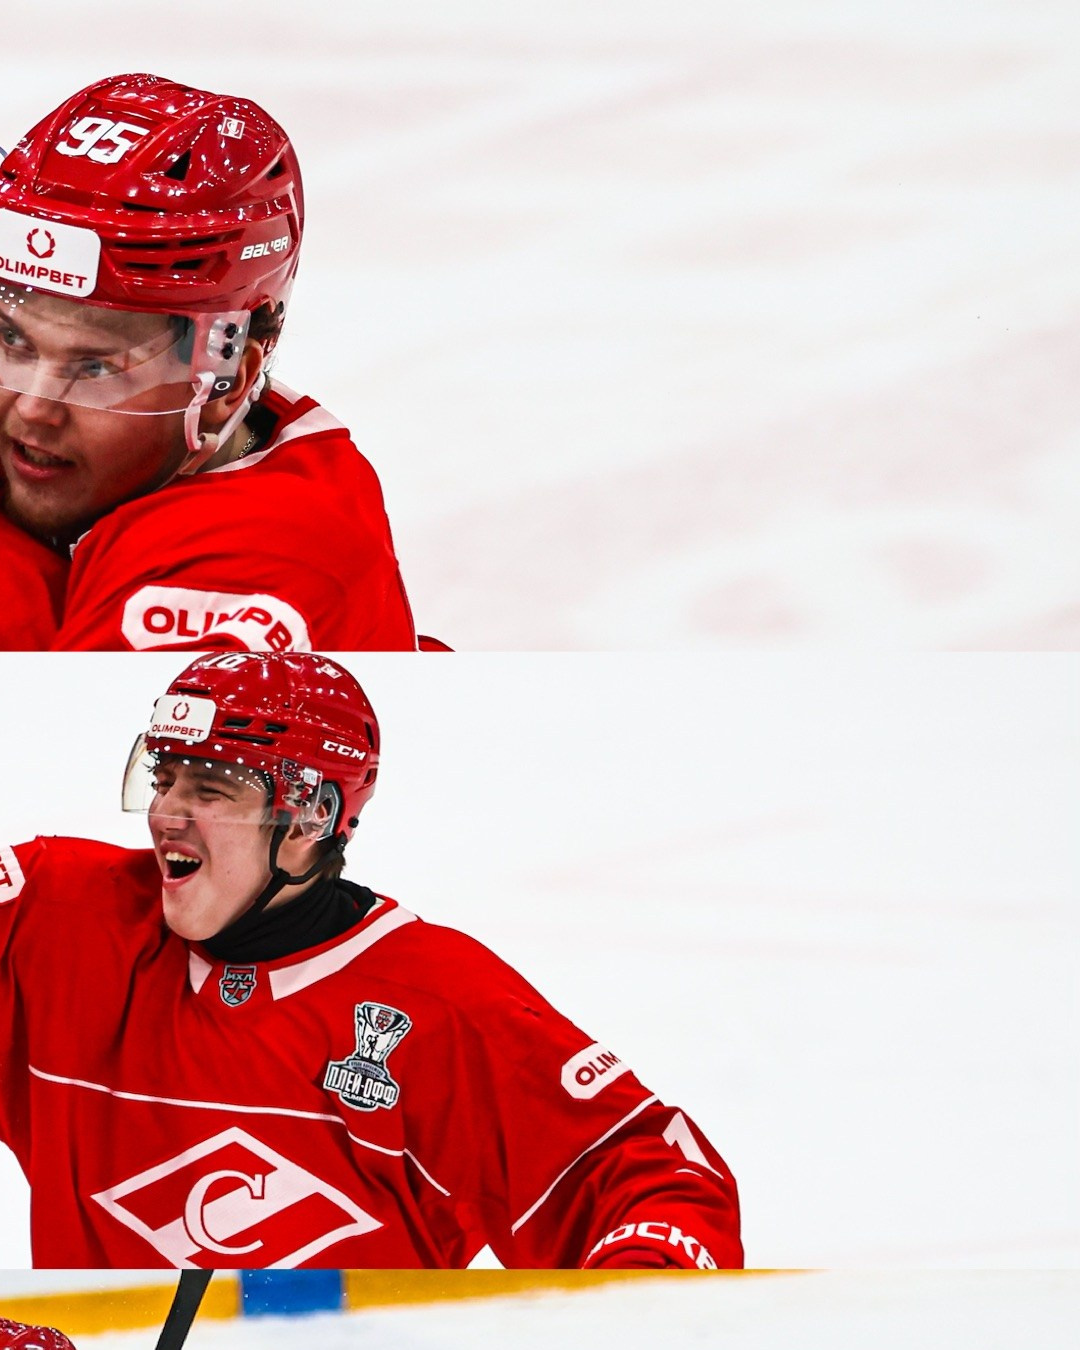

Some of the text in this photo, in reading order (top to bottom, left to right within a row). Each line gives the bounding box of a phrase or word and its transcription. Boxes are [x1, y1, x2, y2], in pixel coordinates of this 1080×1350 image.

[56, 116, 150, 164] 95
[151, 723, 204, 738] OLIMPBET
[321, 738, 367, 761] CCM
[225, 972, 253, 982] МХЛ
[327, 1066, 397, 1105] ПЛЕЙ-ОФФ
